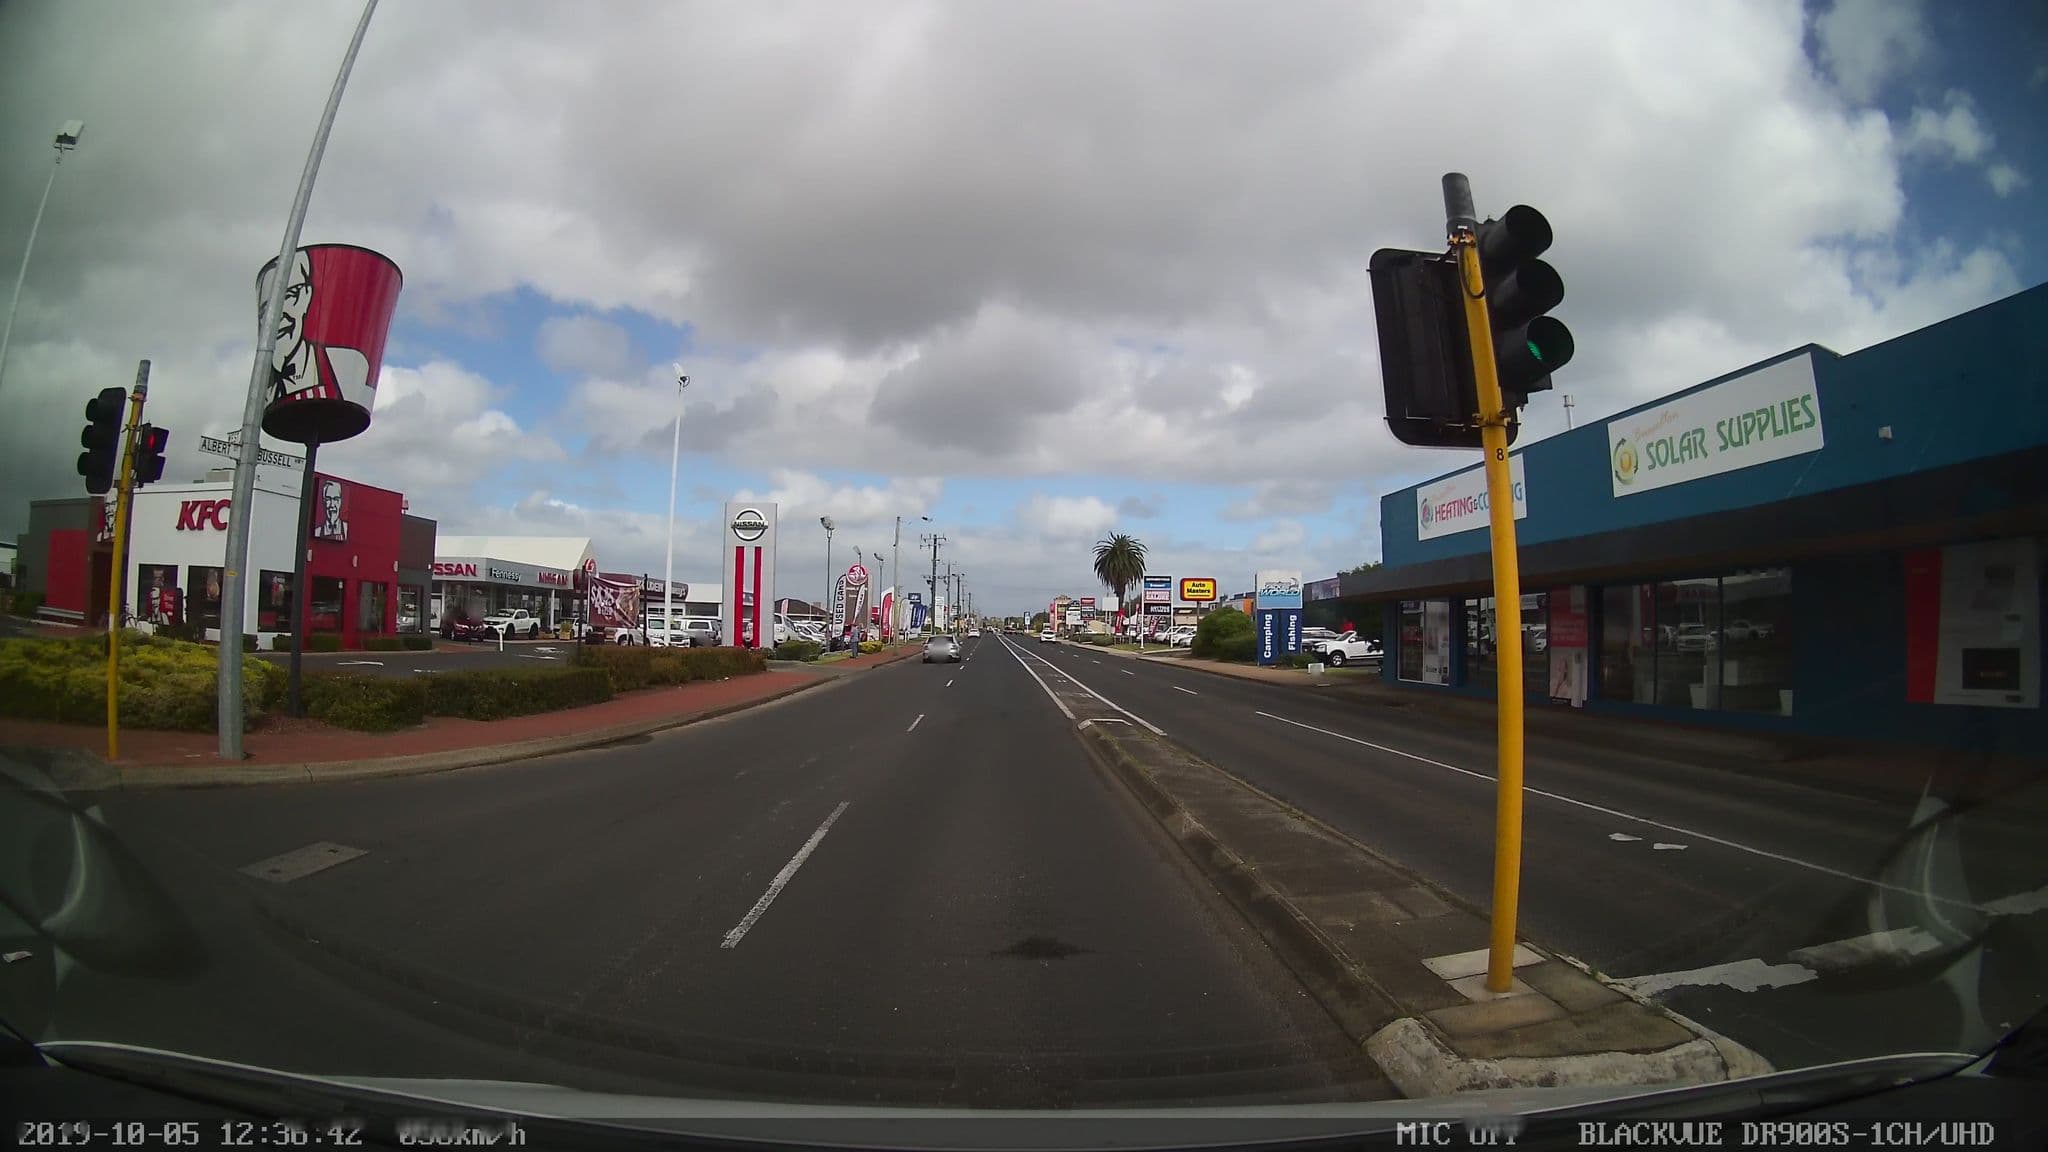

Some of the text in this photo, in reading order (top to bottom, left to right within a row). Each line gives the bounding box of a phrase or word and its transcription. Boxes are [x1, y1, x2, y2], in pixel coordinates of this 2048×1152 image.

[1646, 394, 1816, 470] SOLAR SUPPLIES
[201, 439, 230, 455] ALBERT
[1496, 447, 1504, 461] 8
[257, 450, 291, 467] BUSSELL
[176, 499, 232, 531] KFC
[434, 563, 477, 577] SSAN
[538, 571, 568, 585] NISSAN
[834, 603, 844, 625] USED
[1263, 614, 1272, 658] Camping
[1288, 615, 1297, 650] Fishing
